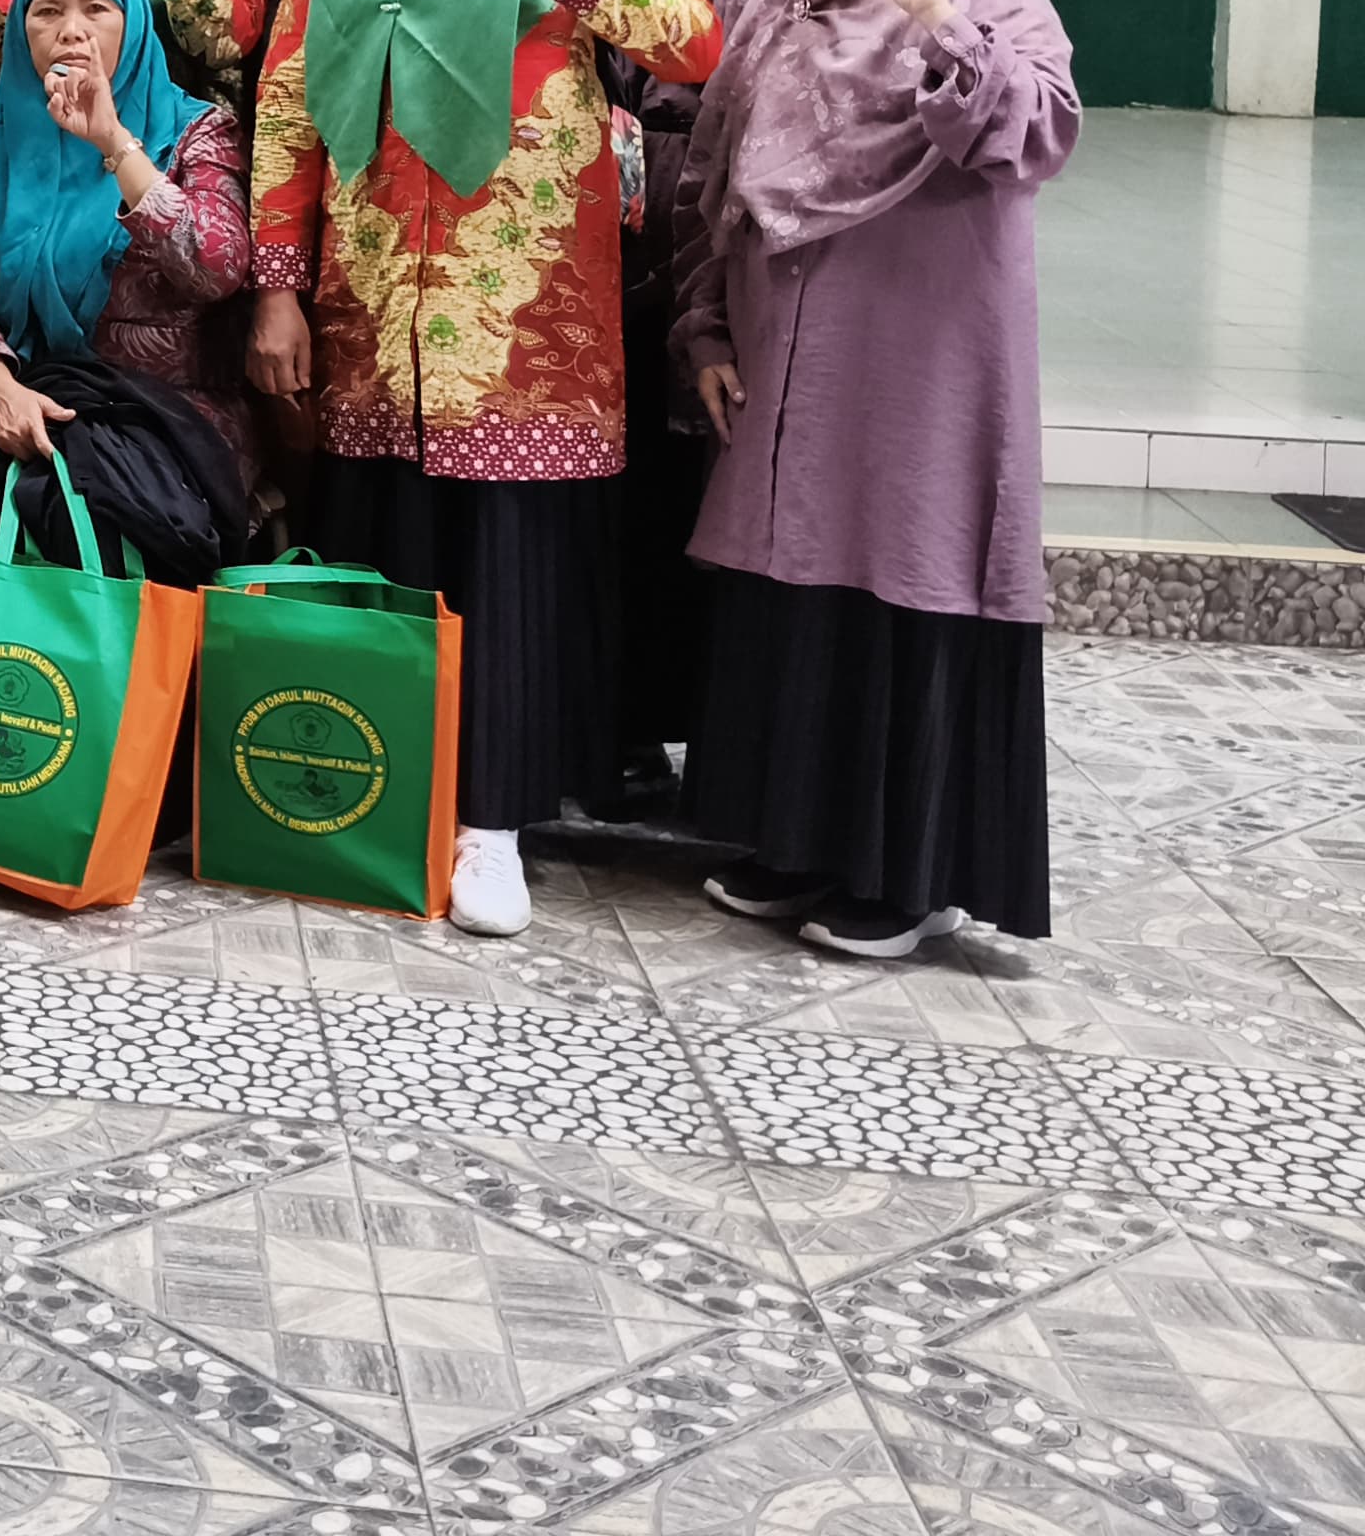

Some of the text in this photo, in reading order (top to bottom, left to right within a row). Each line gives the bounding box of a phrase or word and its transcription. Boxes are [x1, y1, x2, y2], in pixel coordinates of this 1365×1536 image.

[9, 645, 54, 678] MUTTAQIN
[52, 674, 77, 718] SADANG
[237, 711, 258, 737] PPDB
[266, 690, 301, 707] DARUL
[303, 690, 356, 718] MUTTAQIN
[353, 714, 384, 755] SADANG
[19, 776, 40, 791] DAN
[337, 812, 359, 828] DAN
